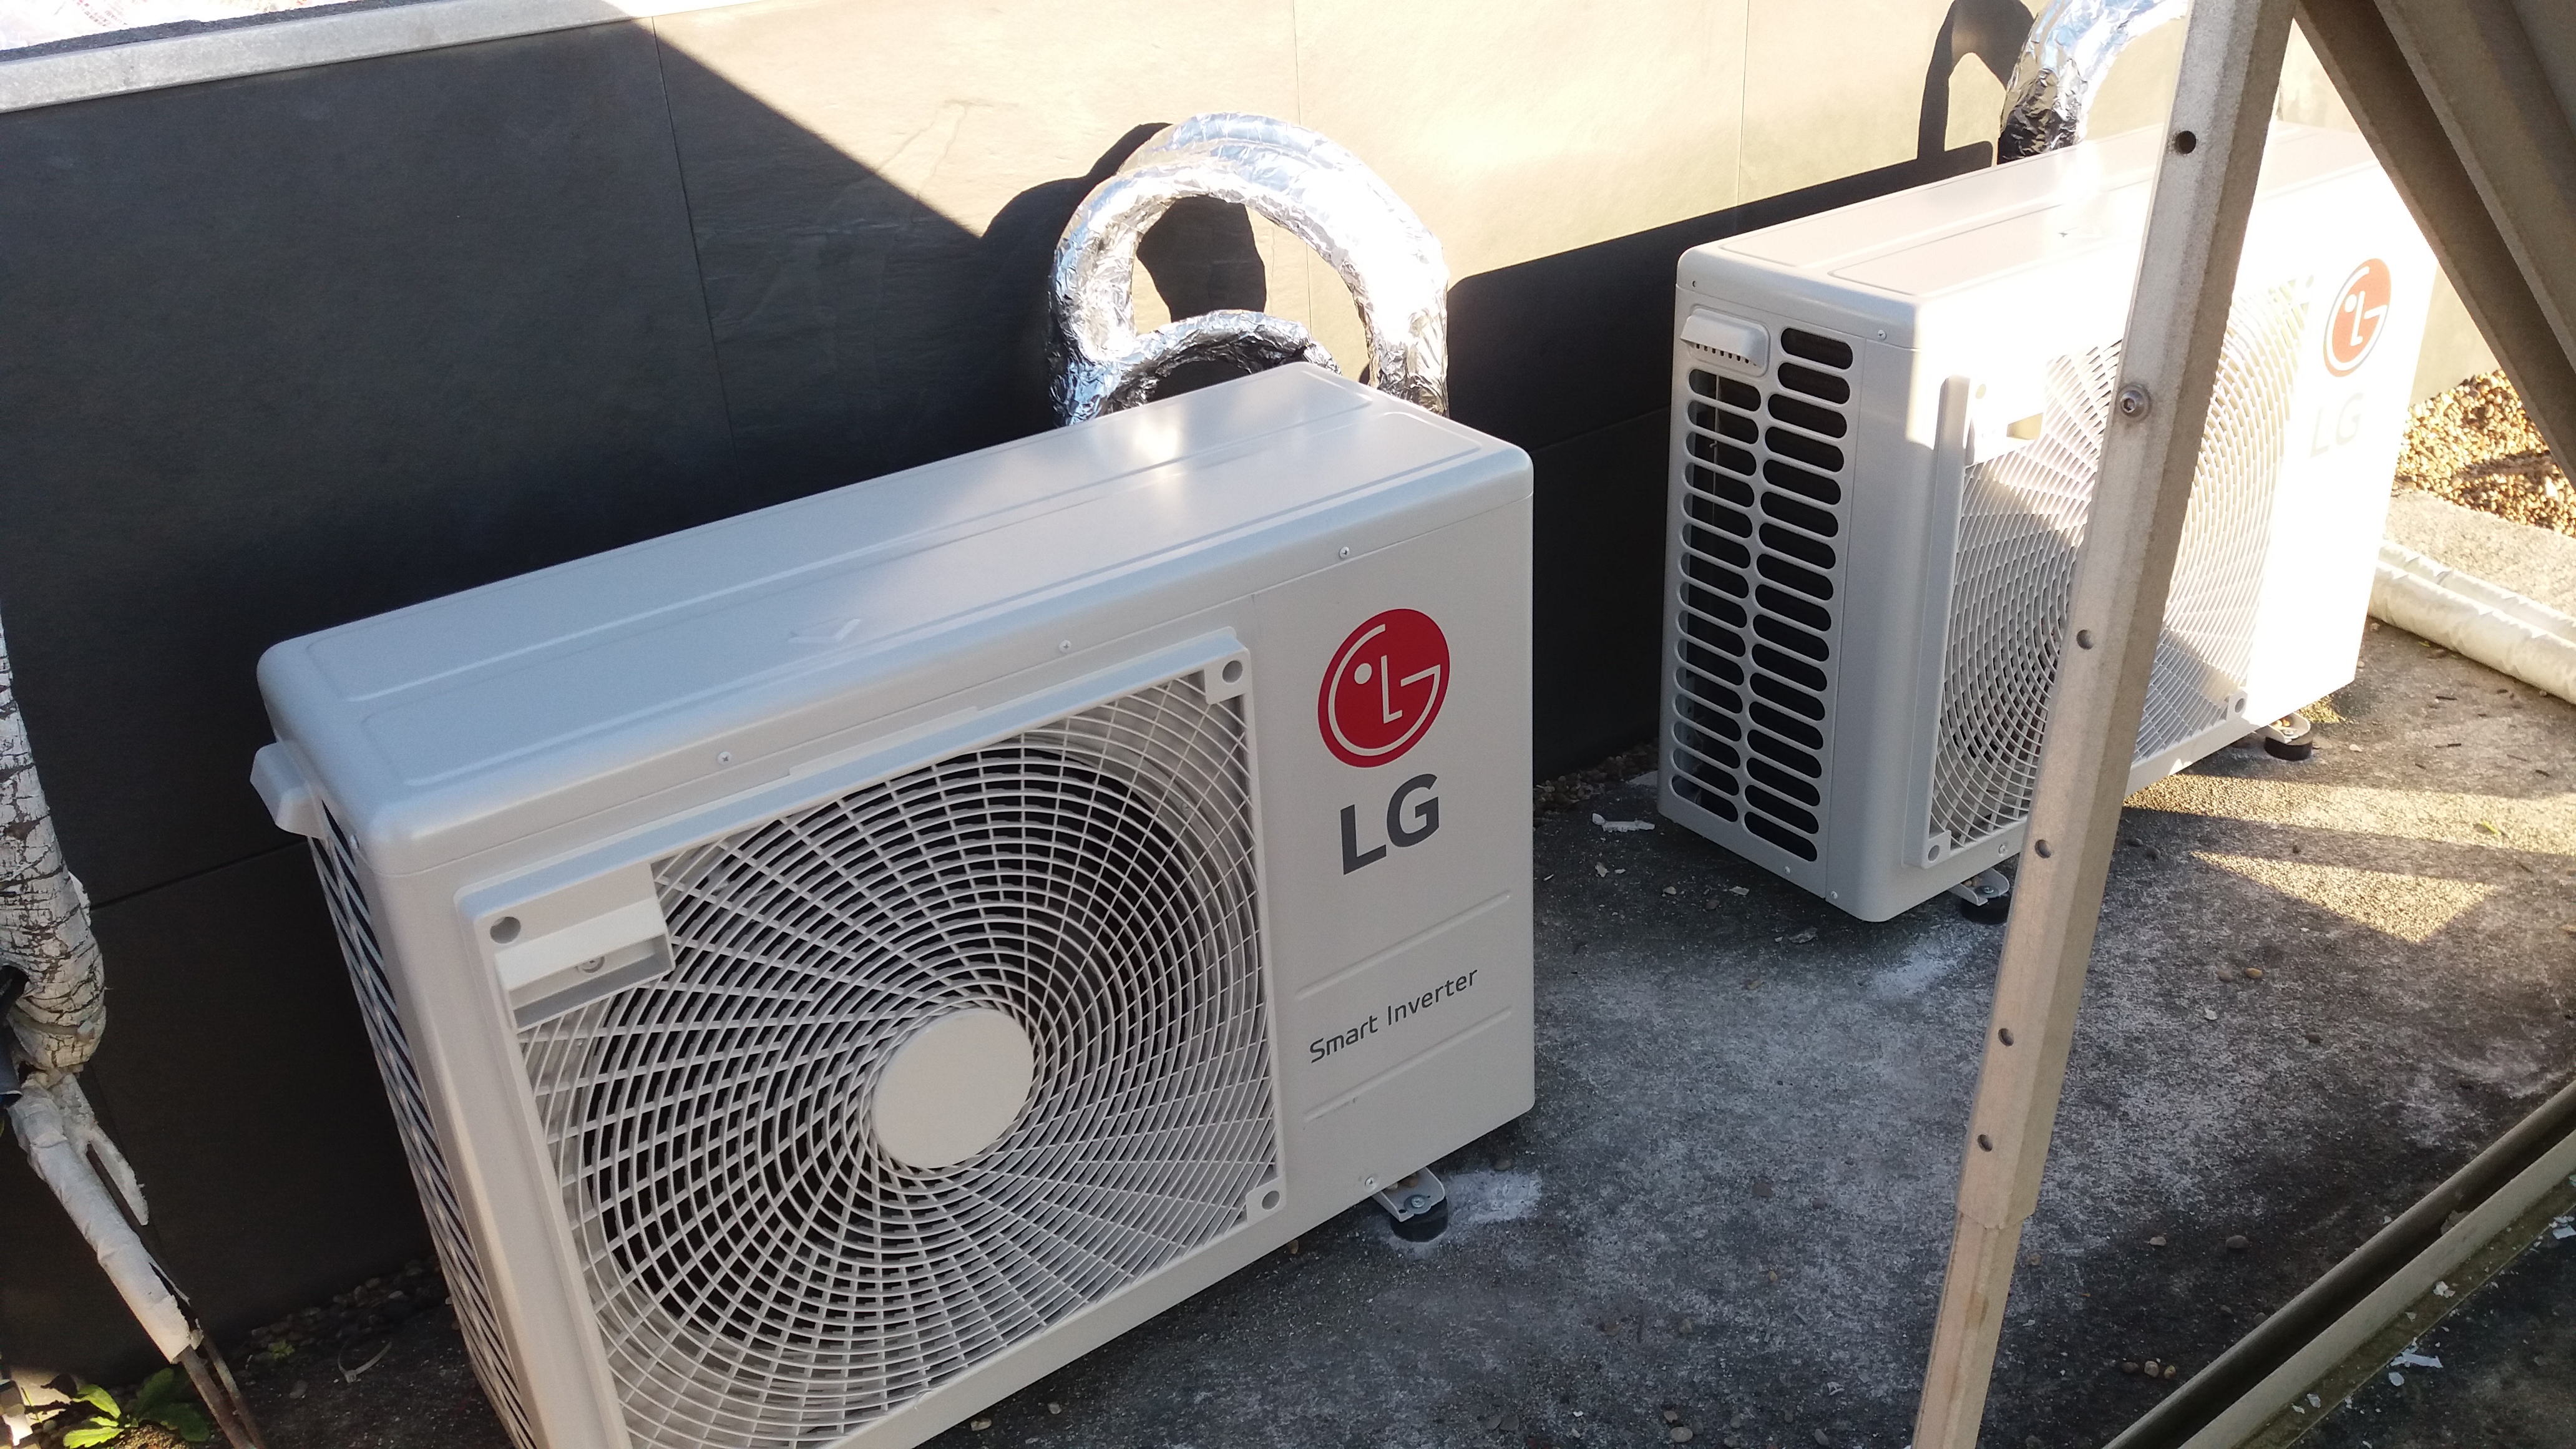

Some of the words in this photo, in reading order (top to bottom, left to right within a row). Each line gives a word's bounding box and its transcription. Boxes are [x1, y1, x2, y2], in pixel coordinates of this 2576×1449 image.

[2326, 266, 2388, 371] LG
[2310, 393, 2364, 457] LG
[1328, 623, 1440, 756] LG
[1340, 773, 1440, 876] LG
[1309, 1015, 1378, 1063] Smart
[1387, 969, 1478, 1026] Inverter
